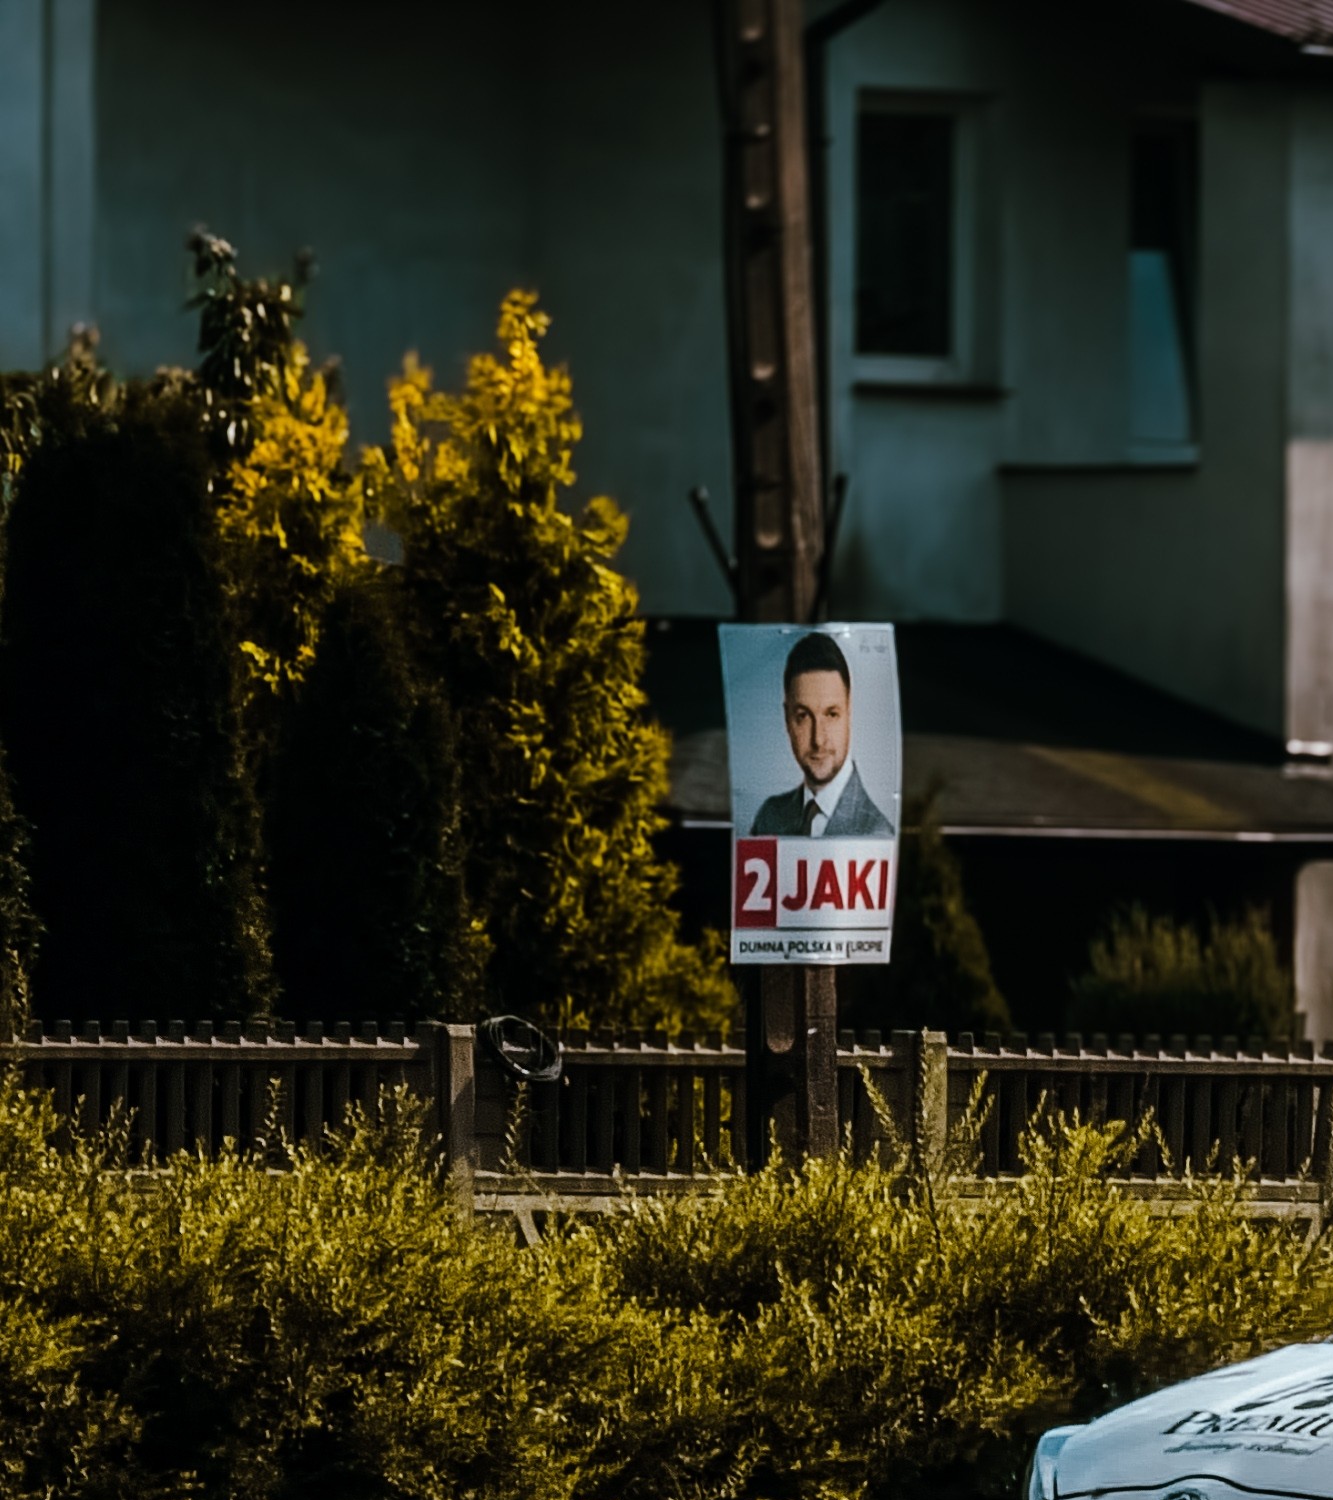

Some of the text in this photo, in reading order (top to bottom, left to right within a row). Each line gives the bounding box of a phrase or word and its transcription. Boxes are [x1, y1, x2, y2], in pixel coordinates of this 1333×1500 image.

[742, 858, 889, 912] 2 JAKI
[739, 941, 784, 953] DUMNA
[787, 940, 832, 953] POLSKA
